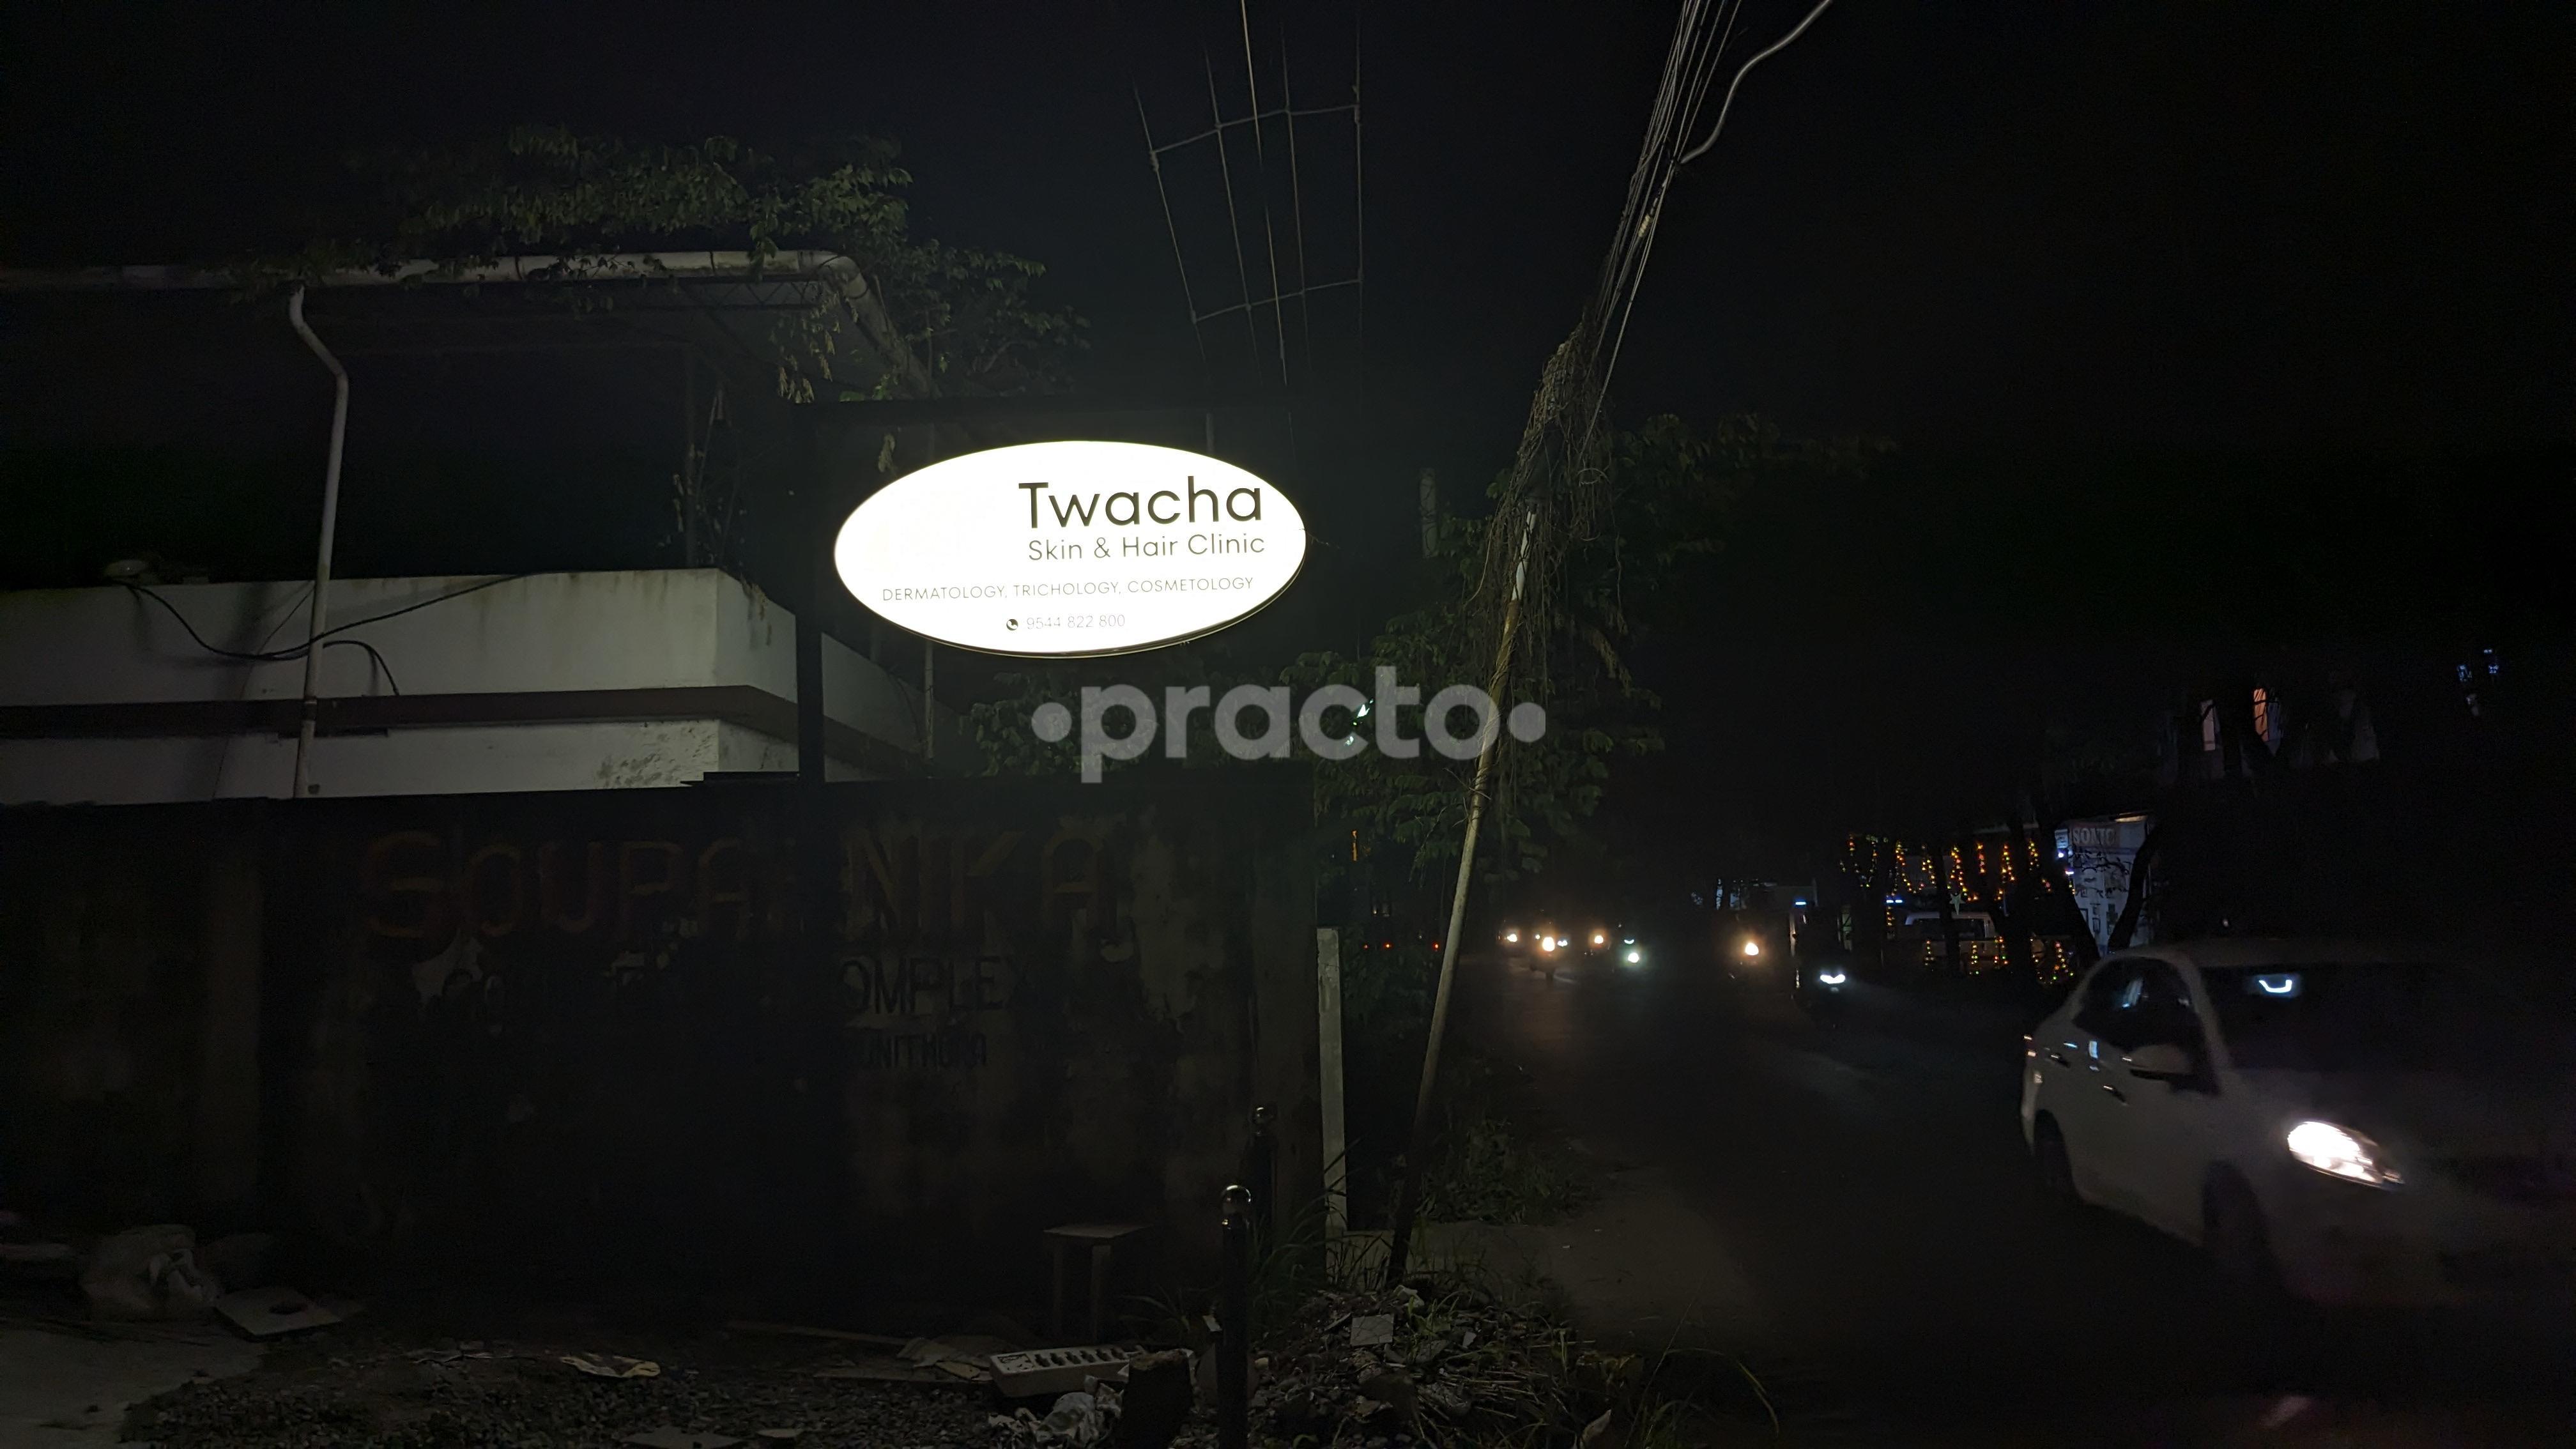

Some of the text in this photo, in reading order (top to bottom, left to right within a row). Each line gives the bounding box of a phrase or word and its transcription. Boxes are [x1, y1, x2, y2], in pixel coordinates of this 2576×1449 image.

[1018, 476, 1262, 529] Twacha
[1029, 533, 1265, 561] Skin & Hair Clinic
[882, 577, 1254, 602] DERMATOLOGY, TRICHOLOGY, COSMETOLOGY
[1026, 614, 1126, 630] 9544 822 800
